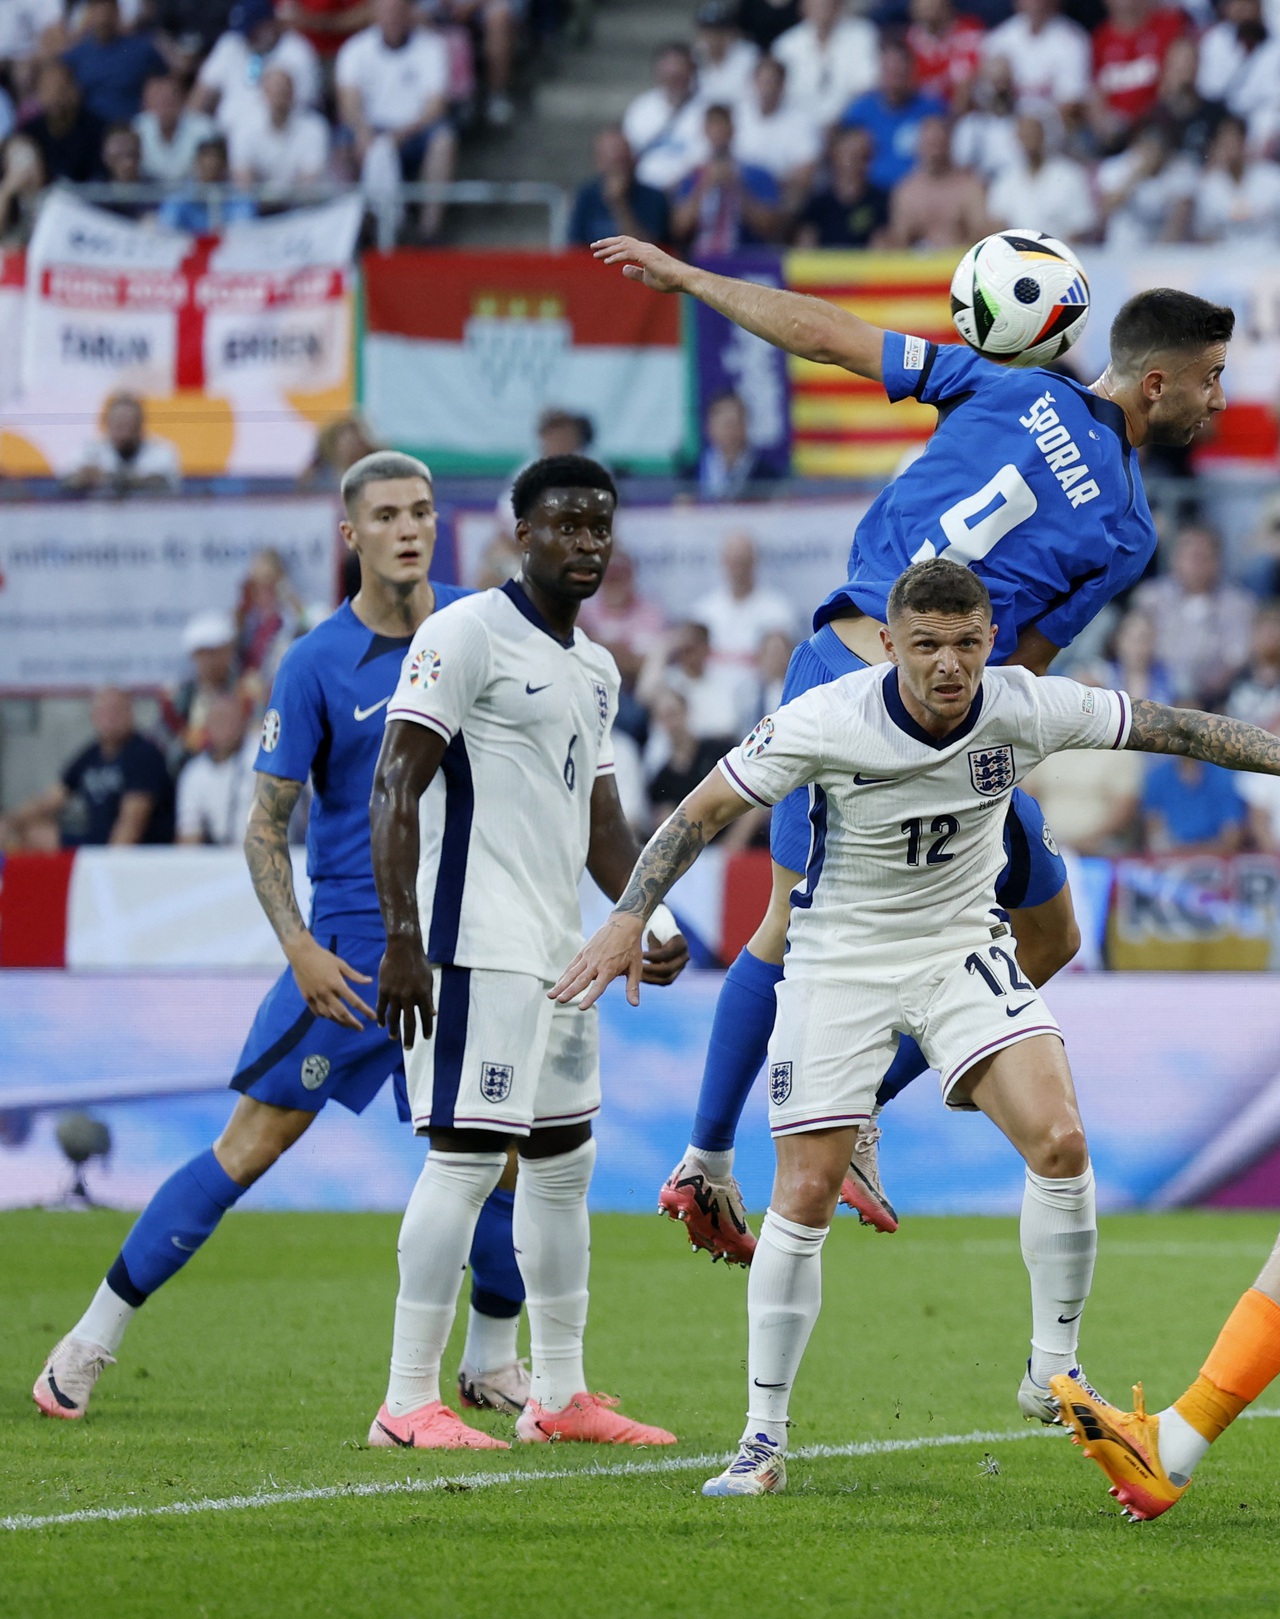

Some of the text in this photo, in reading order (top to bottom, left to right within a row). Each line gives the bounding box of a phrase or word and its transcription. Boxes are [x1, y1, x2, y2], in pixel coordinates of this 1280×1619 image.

[1019, 390, 1101, 509] ŠPORAR
[909, 463, 1038, 566] 9
[564, 735, 577, 791] 6
[901, 814, 960, 866] 12
[963, 945, 1035, 997] 12
